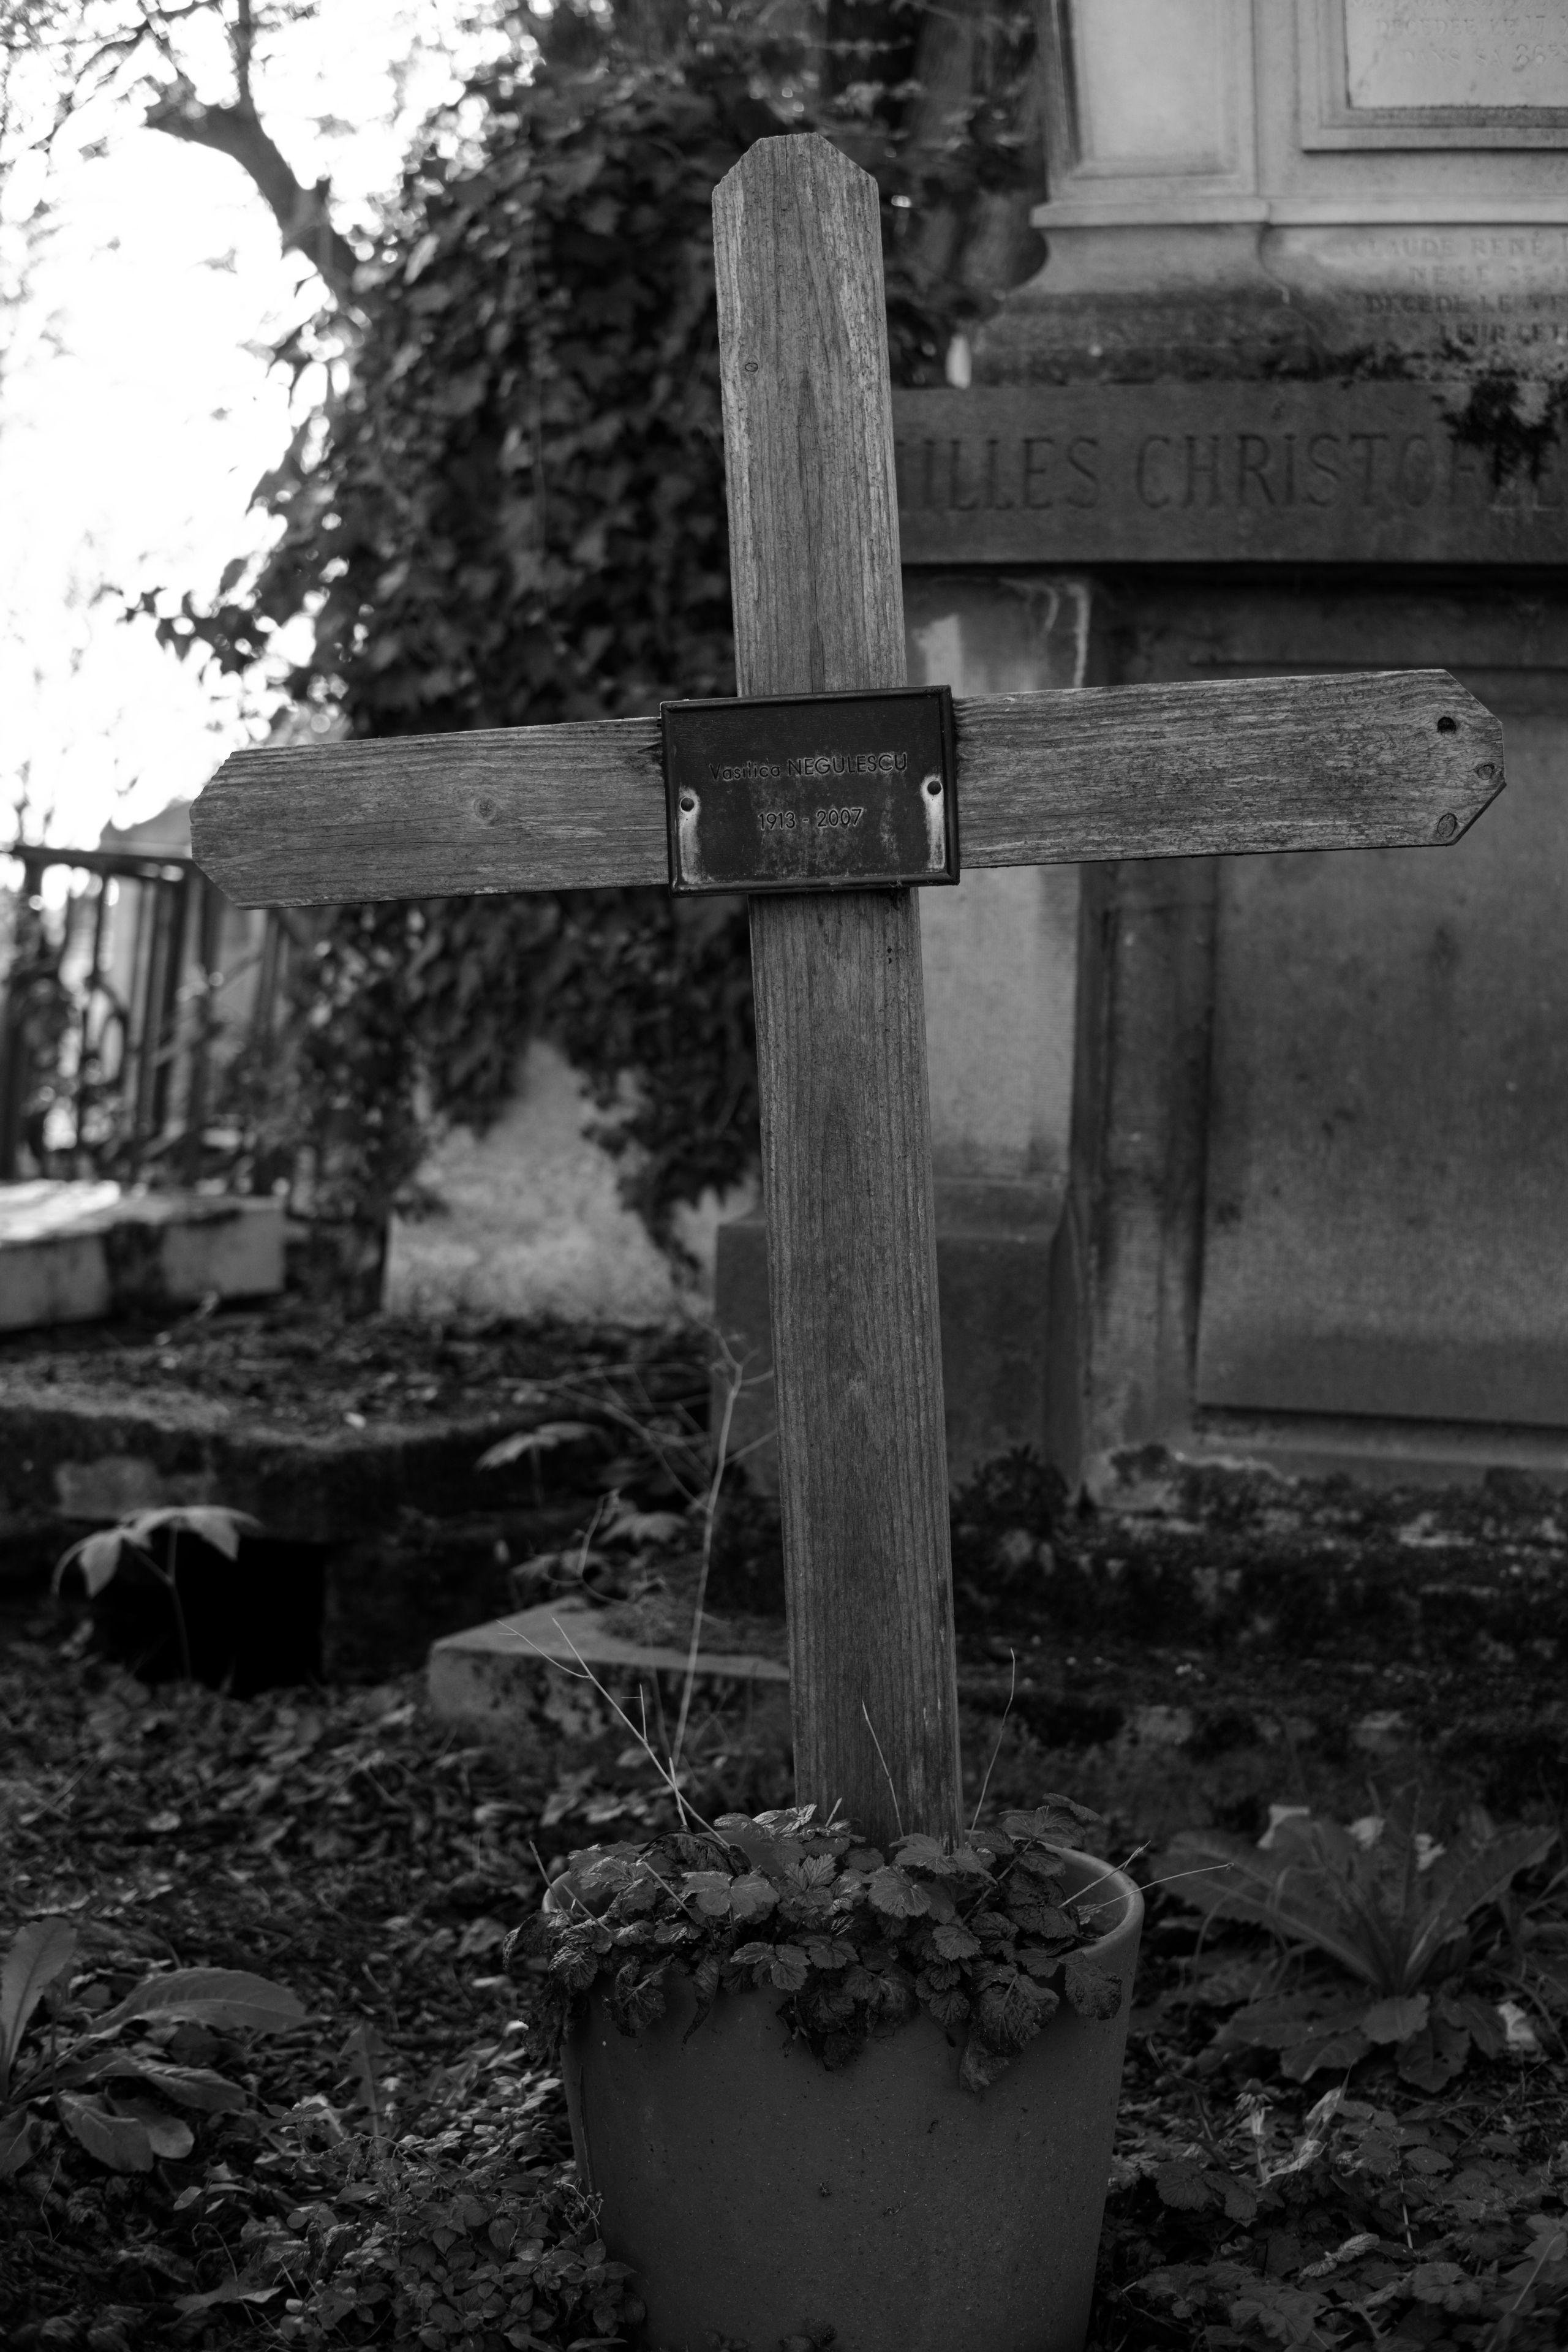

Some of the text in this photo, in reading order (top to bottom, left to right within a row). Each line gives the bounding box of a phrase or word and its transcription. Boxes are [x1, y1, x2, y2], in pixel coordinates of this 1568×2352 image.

[1350, 236, 1455, 258] CLAUDE
[897, 436, 1099, 511] ILLES
[709, 752, 907, 781] Vasilica NEGULESCU
[758, 811, 796, 830] 1913
[816, 807, 864, 827] 2007
